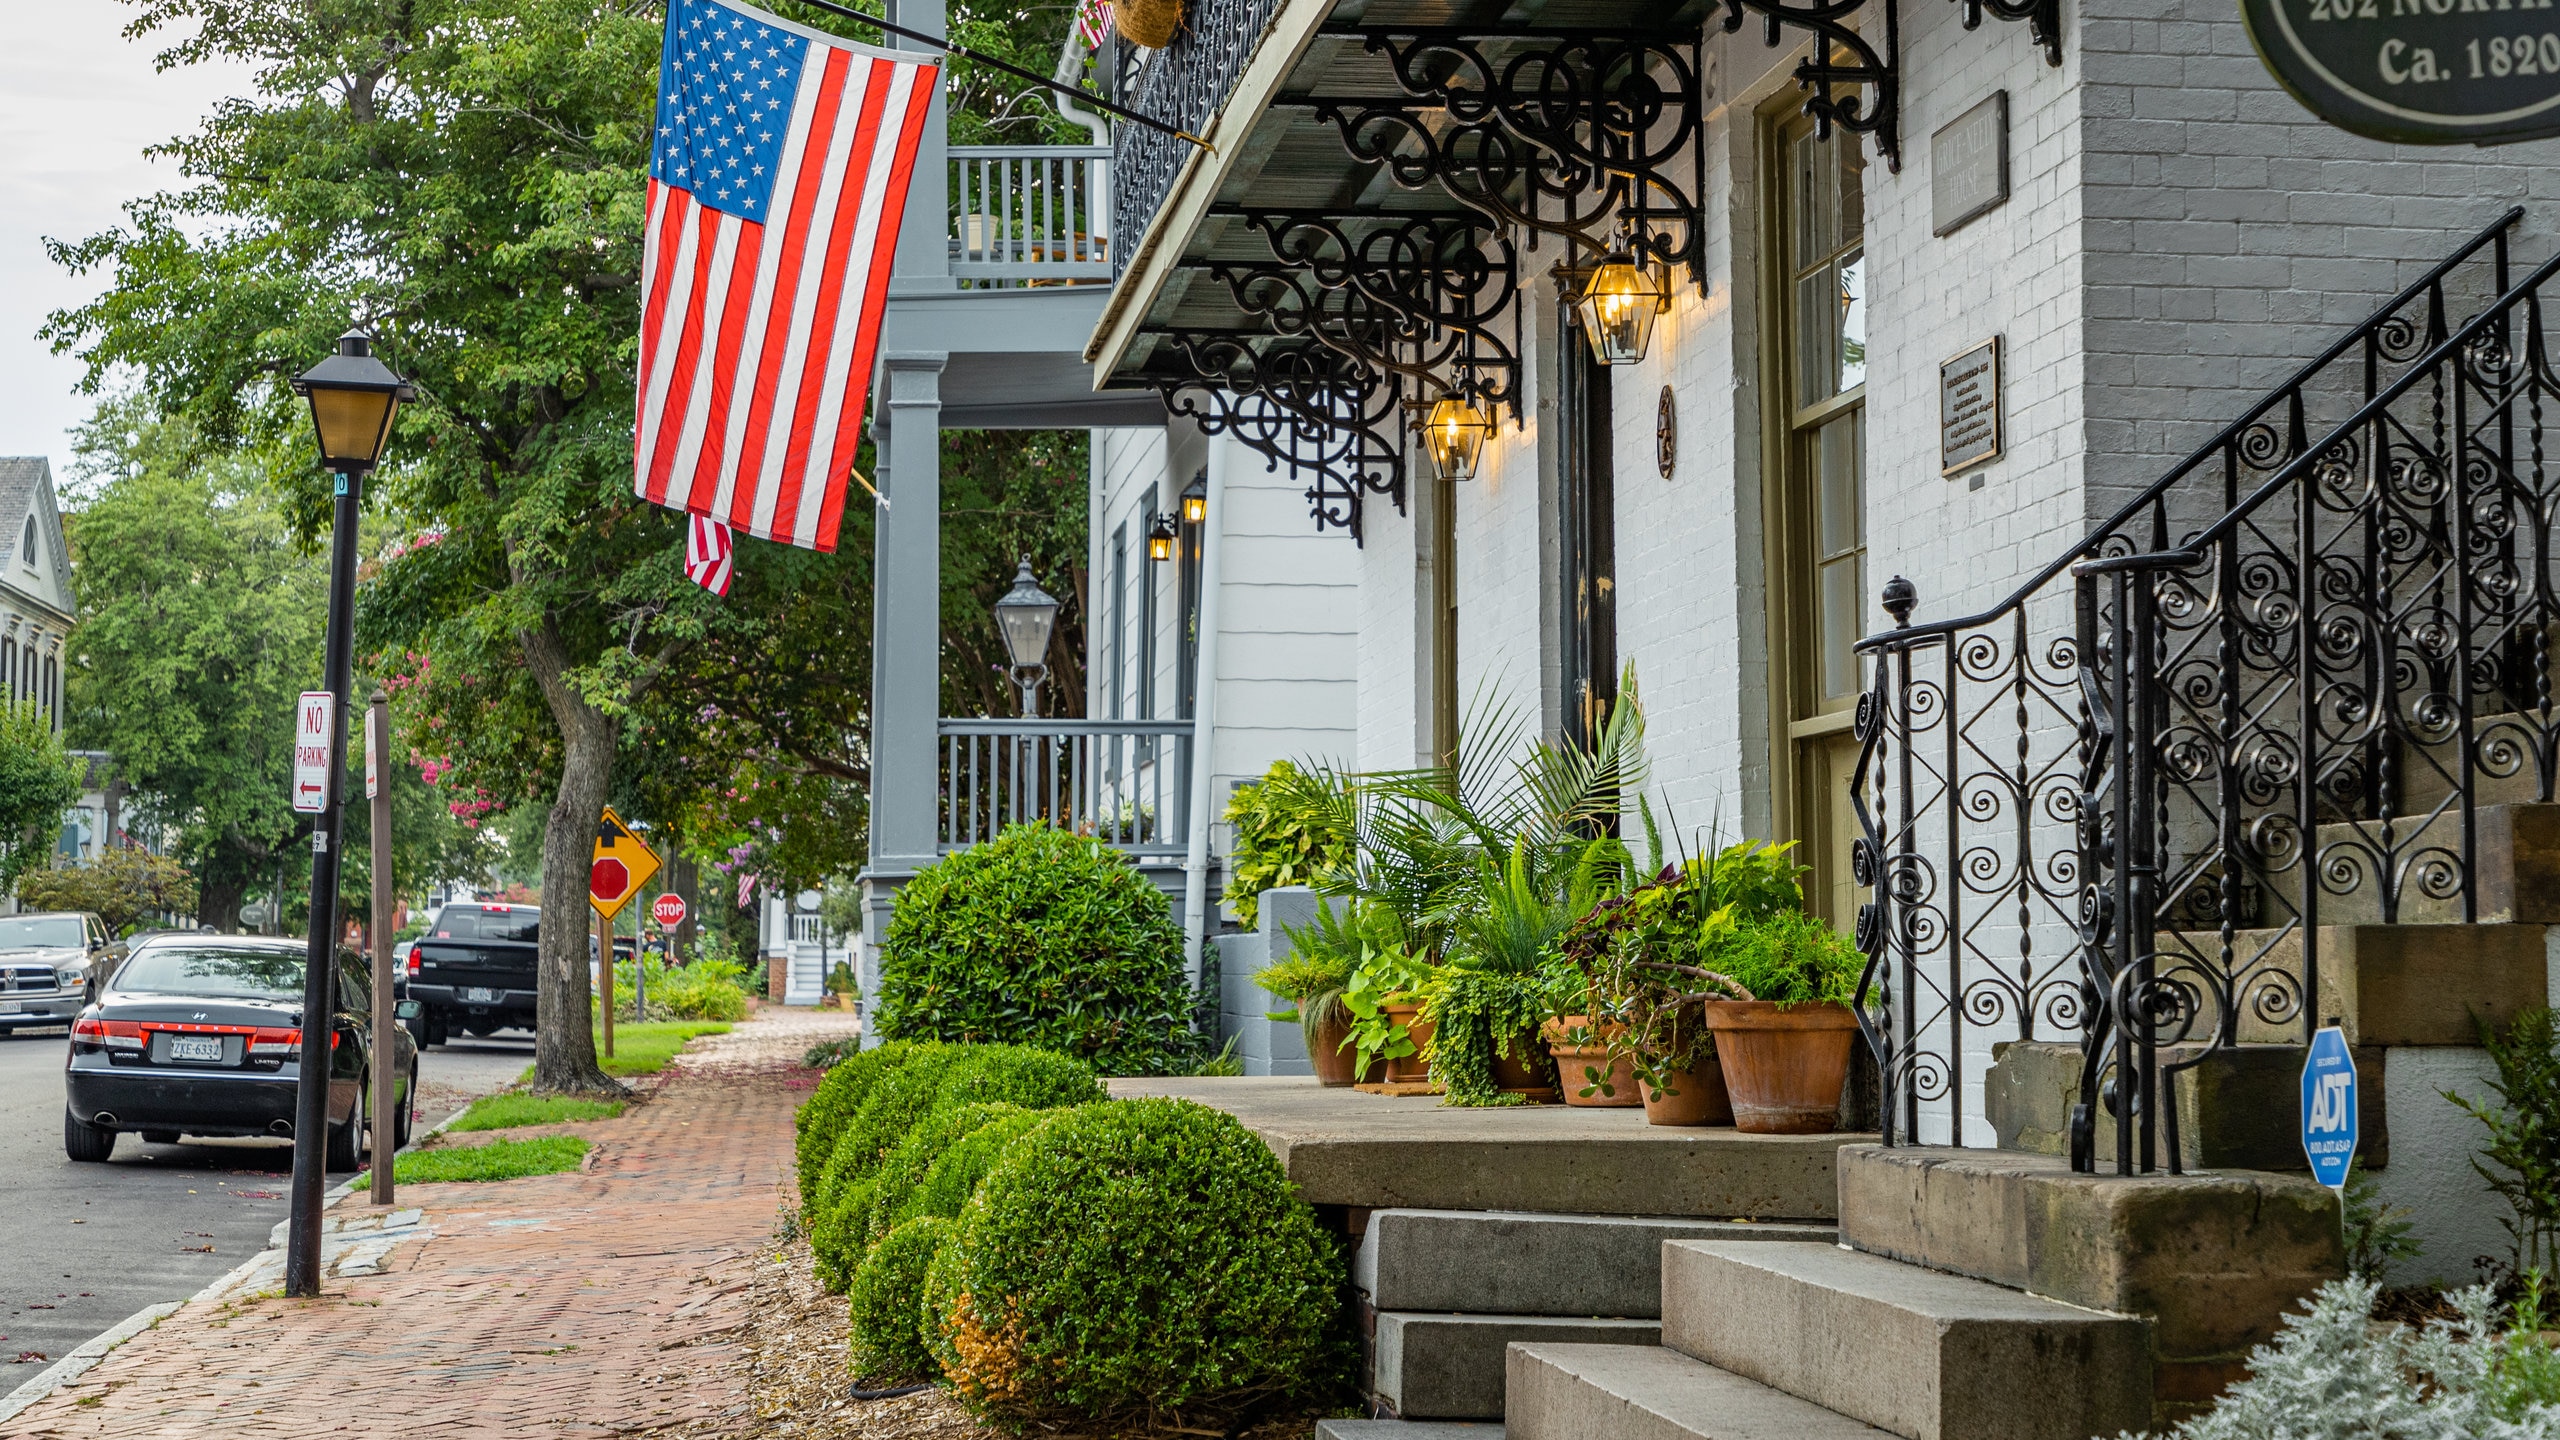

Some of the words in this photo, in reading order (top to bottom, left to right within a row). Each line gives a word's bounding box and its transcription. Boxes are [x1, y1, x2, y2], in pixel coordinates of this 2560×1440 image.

[2378, 38, 2451, 85] Ca.
[2466, 32, 2560, 79] 1820
[1937, 110, 1994, 176] GRICE-NEELY
[1950, 162, 1979, 208] HOUSE
[306, 706, 323, 734] NO
[297, 746, 327, 768] PARKING
[655, 903, 683, 917] STOP
[174, 1042, 219, 1056] ZKE-6332
[2308, 1072, 2351, 1134] ADT
